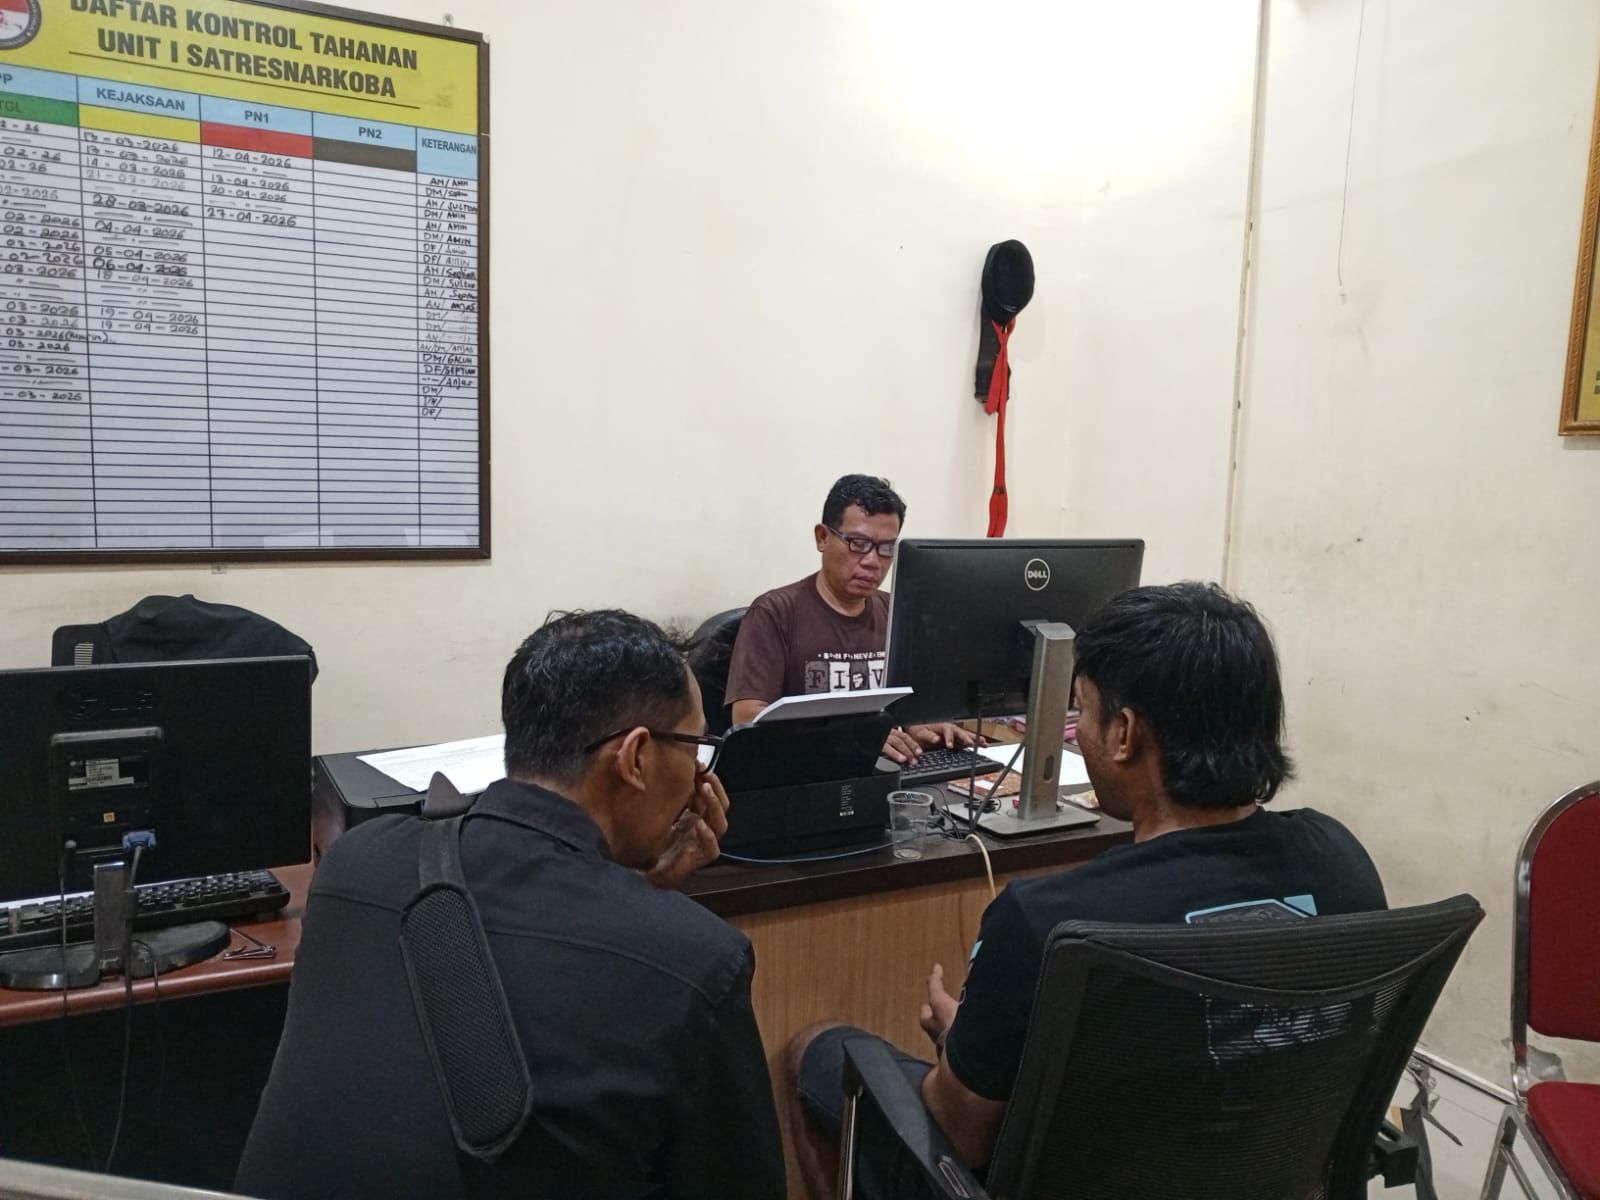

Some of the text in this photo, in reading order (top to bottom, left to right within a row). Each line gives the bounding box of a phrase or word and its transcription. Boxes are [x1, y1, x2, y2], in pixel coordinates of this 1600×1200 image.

[70, 0, 177, 29] DAFTAR
[186, 9, 303, 50] KONTROL
[309, 32, 418, 70] TAHANAN
[98, 28, 396, 98] UNIT I SATRESNARKOBA
[96, 87, 185, 111] KEJAKSAAN
[245, 110, 269, 123] PN1
[358, 126, 382, 140] PN2
[421, 138, 477, 154] KETERANGAN
